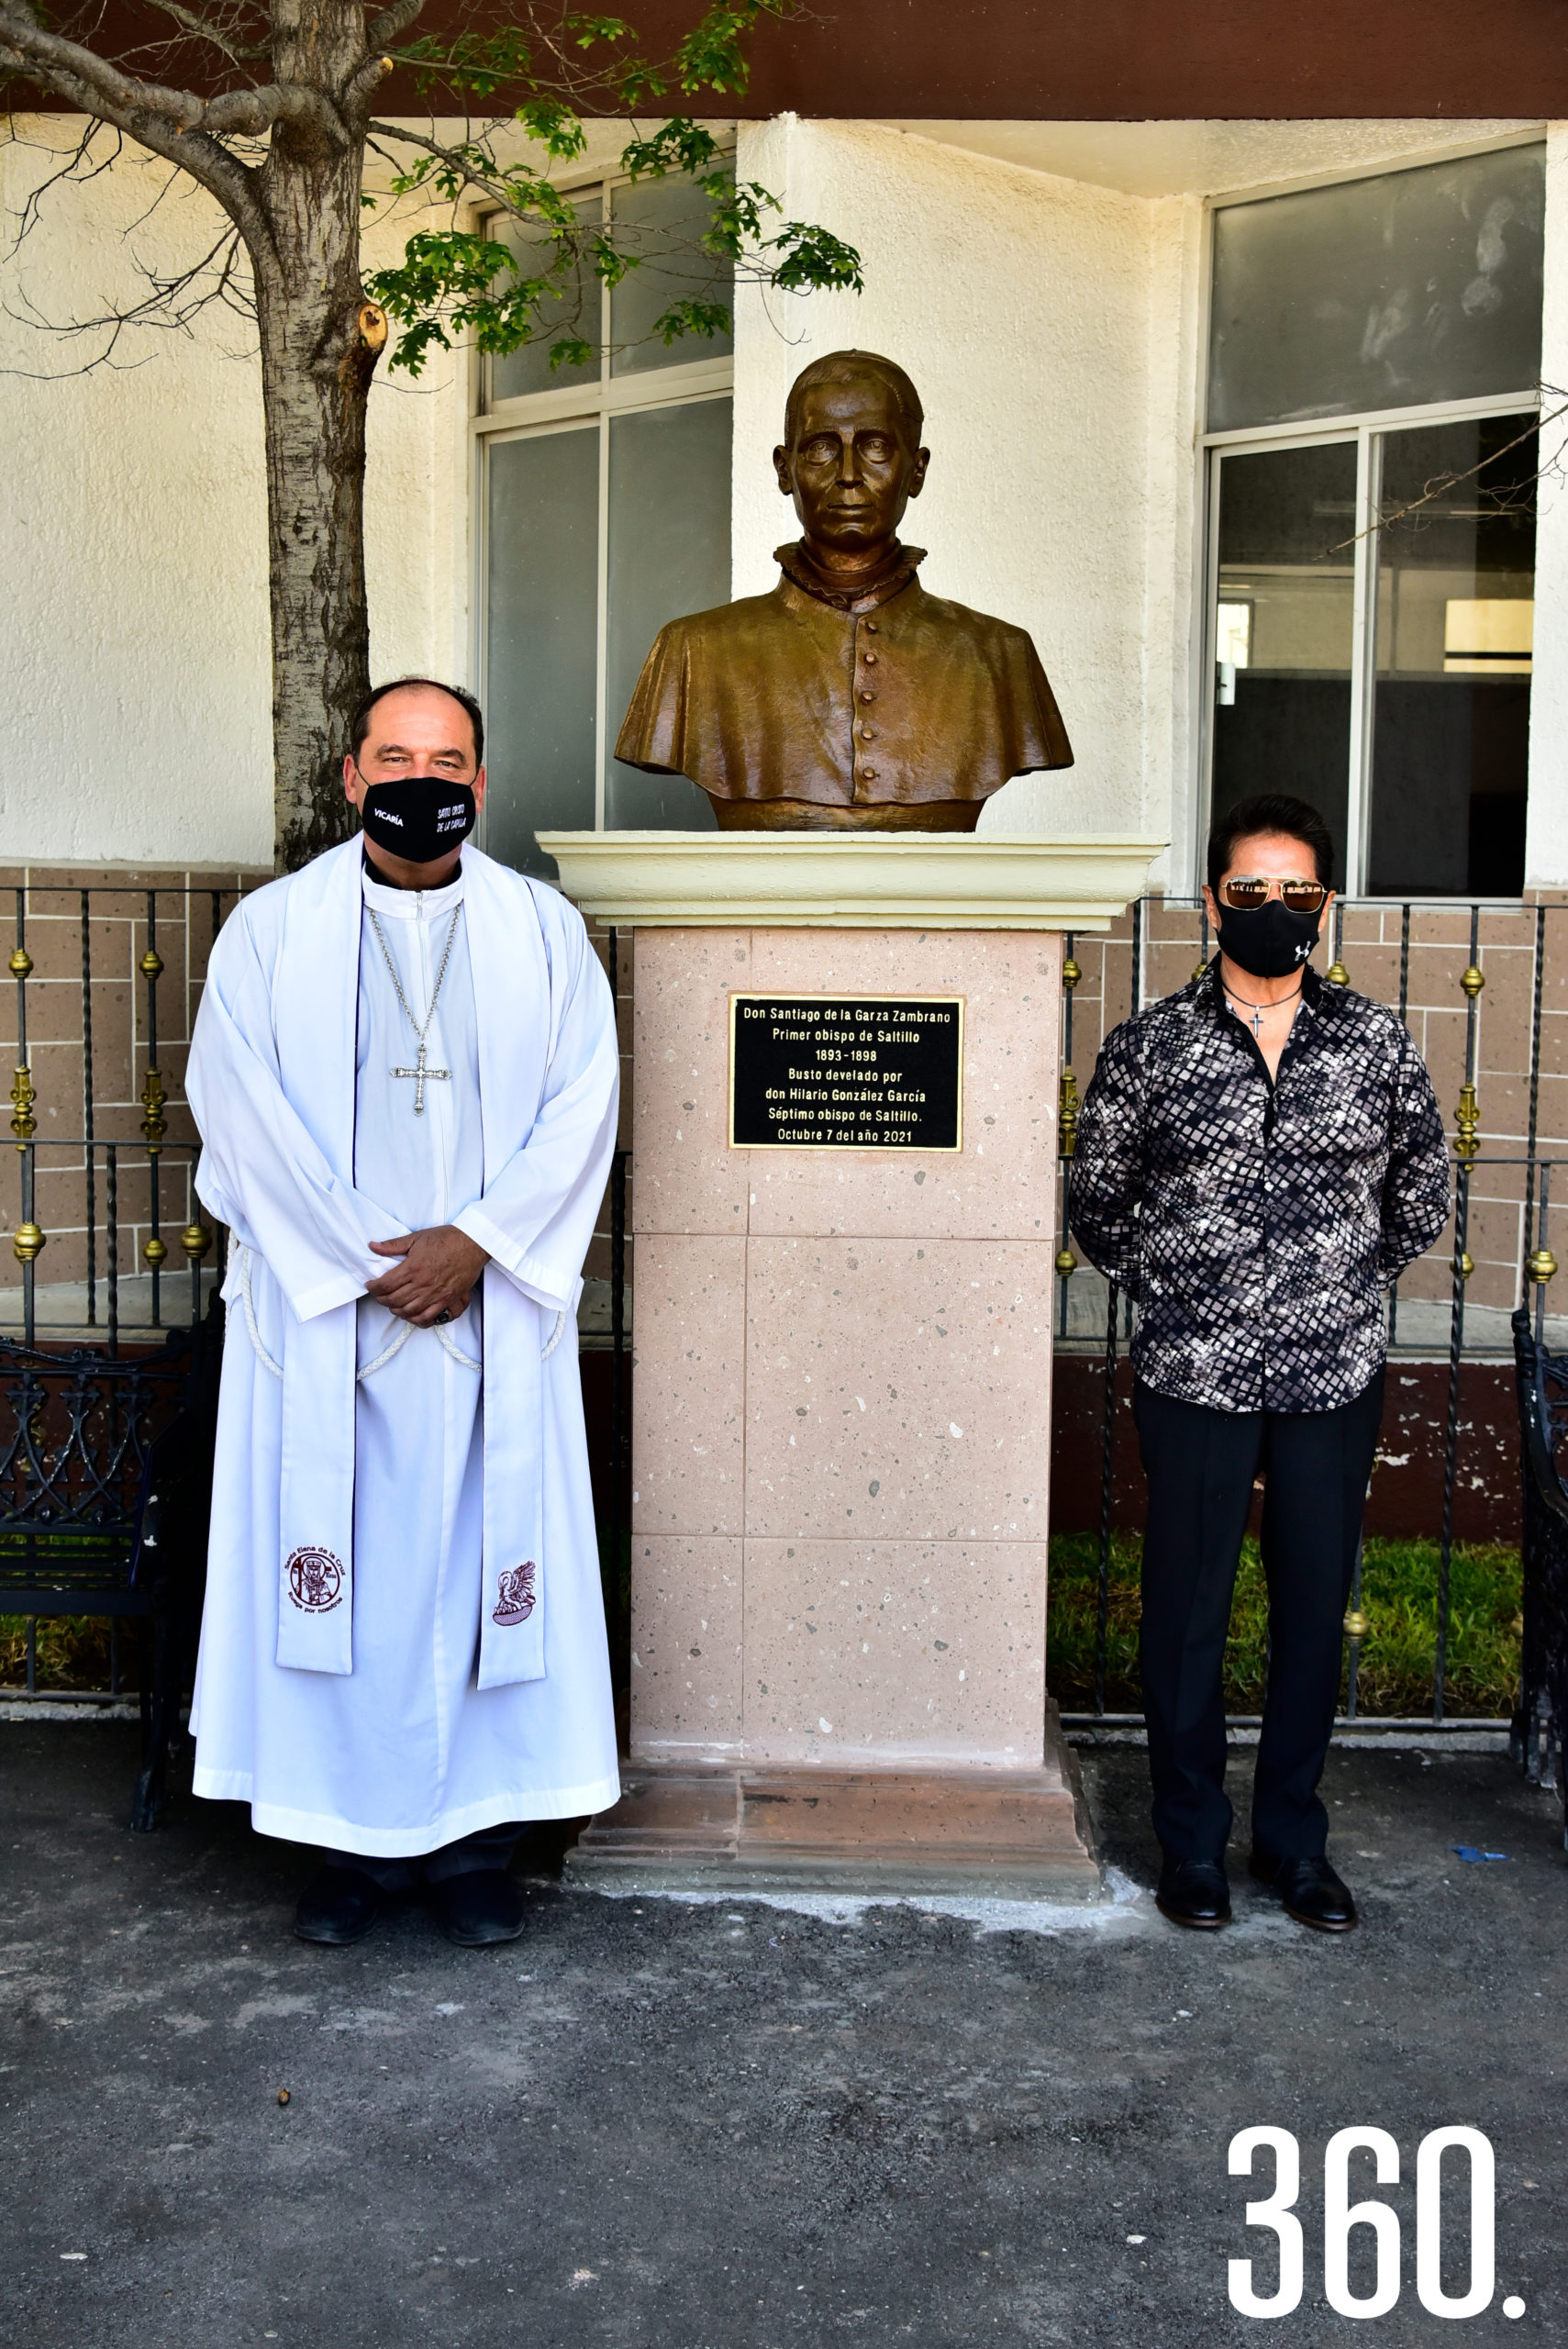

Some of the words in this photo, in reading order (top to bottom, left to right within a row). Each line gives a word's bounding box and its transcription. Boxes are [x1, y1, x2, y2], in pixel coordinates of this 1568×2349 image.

[374, 807, 404, 827] VICARÍA
[437, 822, 444, 833] DE
[744, 1008, 766, 1019] Don
[770, 1008, 820, 1021] Santiago
[825, 1009, 837, 1020] de
[840, 1009, 851, 1020] la
[855, 1009, 888, 1021] Garza
[893, 1010, 951, 1023] Zambrano
[773, 1029, 811, 1041] Primer
[815, 1030, 855, 1043] obispo
[860, 1030, 873, 1041] de
[877, 1030, 919, 1043] Saltillo
[816, 1050, 877, 1062] 1893-1898
[788, 1068, 822, 1080] Busto
[826, 1069, 878, 1082] develado
[883, 1072, 902, 1084] por
[765, 1088, 785, 1099] don
[789, 1089, 828, 1100] Hilario
[831, 1088, 883, 1101] González
[887, 1089, 926, 1102] García
[769, 1106, 815, 1121] Séptimo
[818, 1108, 855, 1123] obispo
[860, 1110, 872, 1121] de
[875, 1110, 922, 1122] Saltillo.
[778, 1129, 822, 1141] Octubre
[827, 1130, 832, 1141] 7
[836, 1130, 853, 1141] del
[857, 1130, 878, 1141] año
[884, 1130, 912, 1142] 2021
[284, 1552, 296, 1570] Santa
[328, 1551, 336, 1559] la
[335, 1558, 346, 1576] Cruz
[288, 1591, 303, 1609] Ruega
[317, 1597, 343, 1613] nosotros
